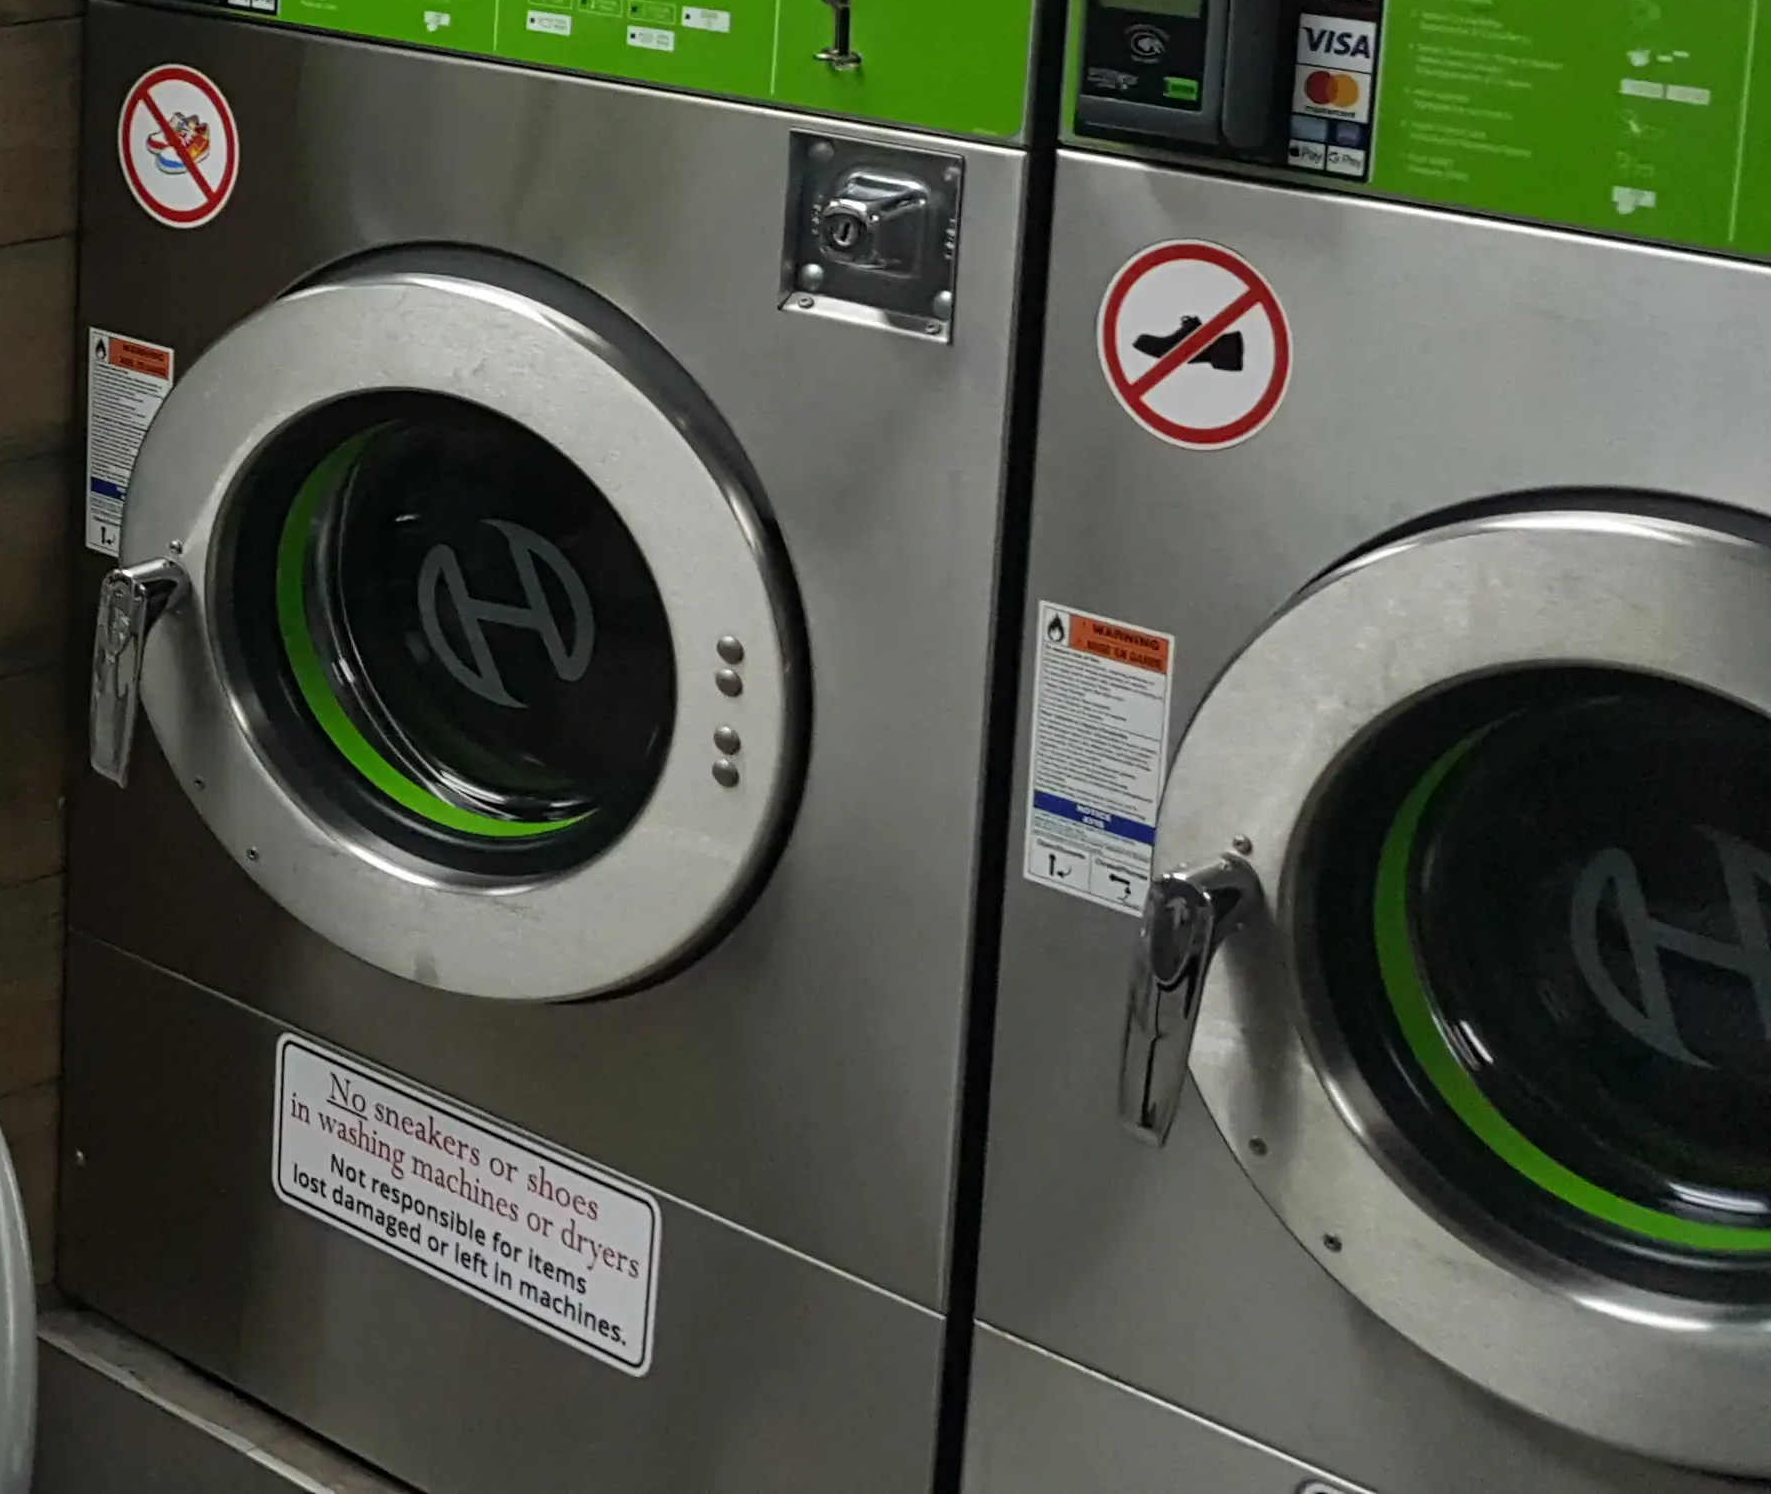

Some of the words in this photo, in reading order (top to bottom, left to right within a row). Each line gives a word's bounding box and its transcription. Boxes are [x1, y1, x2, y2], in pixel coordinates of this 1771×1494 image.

[1303, 26, 1371, 59] VISA
[1300, 146, 1322, 165] Pay
[1092, 623, 1160, 651] WARNING
[291, 1092, 311, 1125] in
[319, 1110, 405, 1180] washing
[412, 1155, 519, 1222] machines
[527, 1210, 554, 1238] or
[561, 1218, 640, 1279] dryers
[327, 1072, 368, 1119] No
[374, 1102, 481, 1167] sneakers
[489, 1156, 518, 1183] or
[527, 1166, 599, 1221] shoes
[293, 1163, 328, 1199] lost
[333, 1183, 422, 1246] damaged
[428, 1234, 450, 1256] or
[455, 1241, 488, 1278] left
[494, 1261, 513, 1290] in
[519, 1279, 626, 1346] machines.
[331, 1153, 367, 1189] Not
[372, 1176, 486, 1246] responsible
[492, 1232, 523, 1262] for
[529, 1248, 588, 1296] items
